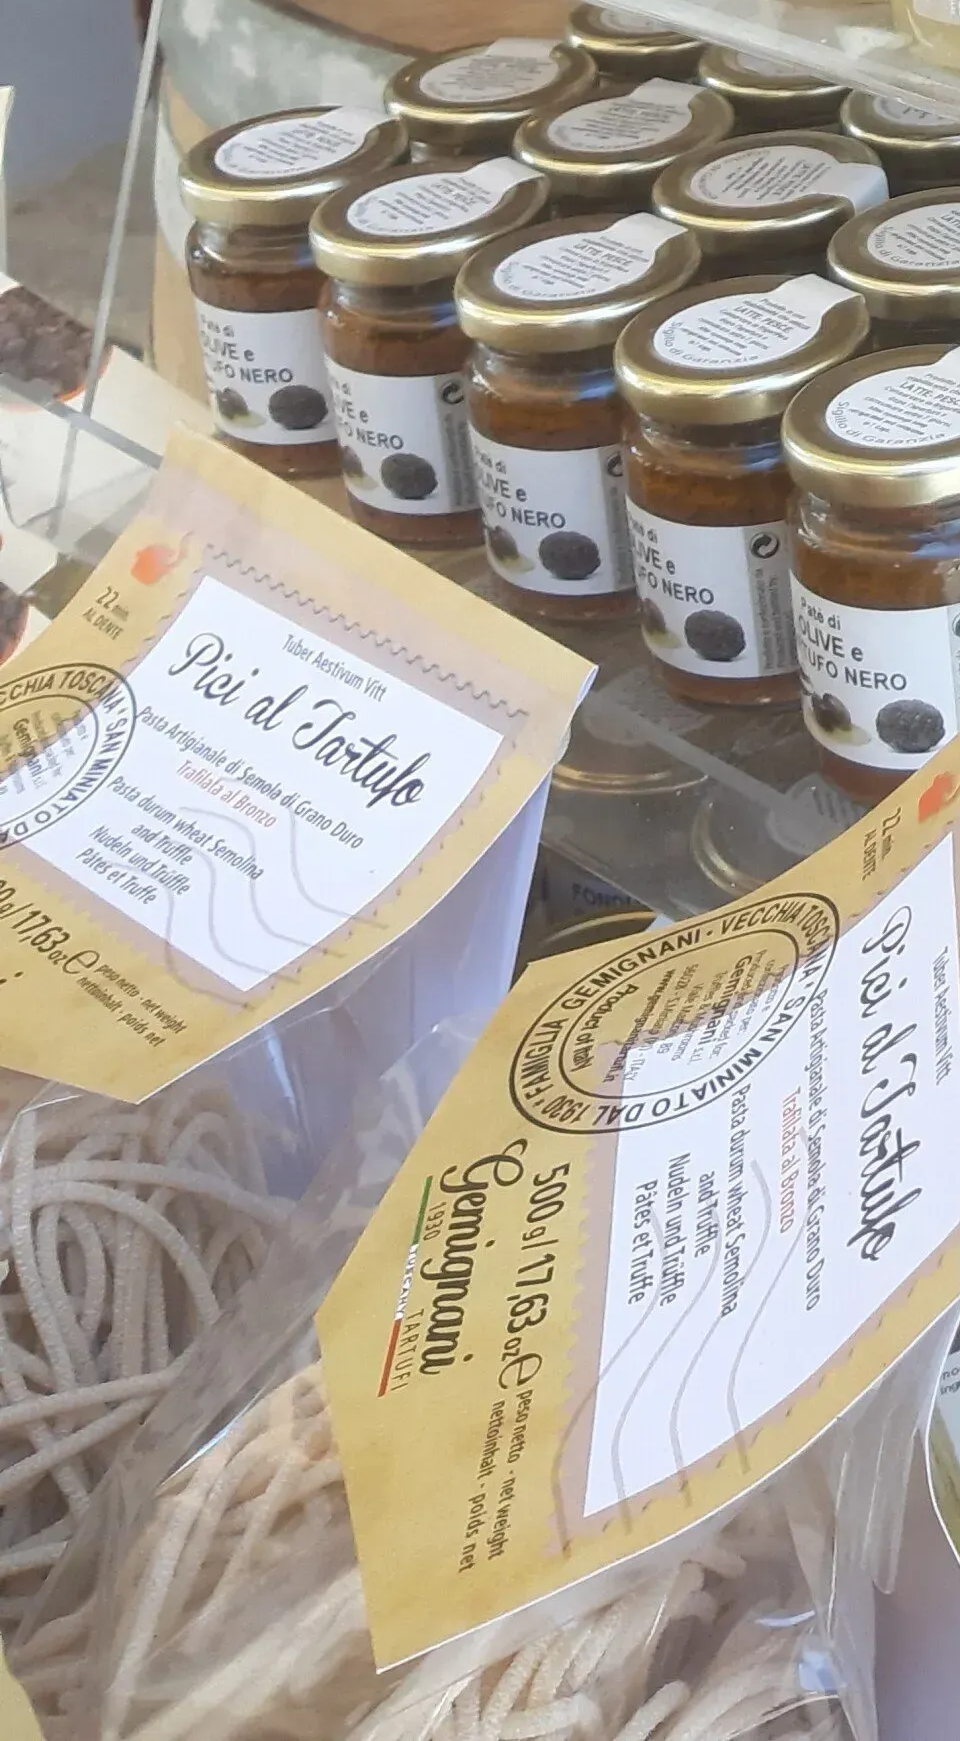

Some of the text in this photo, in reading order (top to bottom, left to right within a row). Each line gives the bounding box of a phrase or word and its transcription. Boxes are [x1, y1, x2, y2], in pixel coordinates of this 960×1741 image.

[761, 315, 795, 334] PESCE
[240, 367, 294, 384] NERO
[244, 349, 255, 362] e
[356, 430, 404, 452] NERO
[359, 409, 369, 423] e
[831, 401, 946, 446] Sigillo di Garanzia
[510, 507, 567, 530] NERO
[515, 486, 528, 503] e
[661, 576, 715, 607] NERO
[665, 558, 677, 576] e
[96, 586, 120, 610] 22
[826, 614, 842, 632] di
[94, 614, 125, 642] DENTE
[798, 614, 864, 663] OLIVE e
[282, 633, 389, 703] Tuber Aestivum Vitt
[843, 665, 908, 692] NERO
[34, 670, 128, 824] TOSCANA SAN MINIATO
[168, 632, 431, 809] Pici al Tartufo
[135, 706, 365, 851] Pasta Artigianale di Semola di Grano Duro
[176, 759, 278, 830] Trafilata al Bronzo
[107, 775, 265, 882] Pasta durum wheat Semolina
[130, 823, 194, 867] and Truffle
[881, 806, 903, 839] 22
[75, 847, 158, 906] Pâtes et Truffe
[88, 824, 193, 897] Nudeln und Trüffle
[861, 841, 878, 882] DENTE
[720, 902, 806, 935] VECCHIA
[799, 904, 835, 982] TOSCANA
[560, 928, 701, 1011] GEMIGNANI
[94, 963, 189, 1036] peso netto weight
[585, 982, 640, 1032] Product
[700, 954, 753, 1045] Gemignani
[758, 998, 801, 1044] SAN
[116, 1011, 168, 1049] poids net
[520, 1018, 568, 1100] FAMIGLIA
[541, 1094, 593, 1125] 1930
[651, 1048, 764, 1118] MINIATO
[846, 904, 923, 1263] Pici al Tartufo
[592, 1102, 643, 1127] DAL
[779, 1085, 803, 1235] Trafilata al Bronzo
[804, 987, 829, 1312] Pasta Artigianale di Semola di Grano Duro
[659, 1151, 691, 1308] Nudeln und Trüffle
[693, 1169, 719, 1259] and Truffle
[719, 1083, 752, 1319] Pasta durum wheat Semolina
[418, 1137, 529, 1376] Gemignani
[627, 1178, 658, 1306] Pâtes et Truffe
[389, 1200, 448, 1393] 1930 TARTUFI
[486, 1161, 571, 1562] 500 17,63 peso netto net weight
[457, 1399, 506, 1574] nettoinhalt poids net
